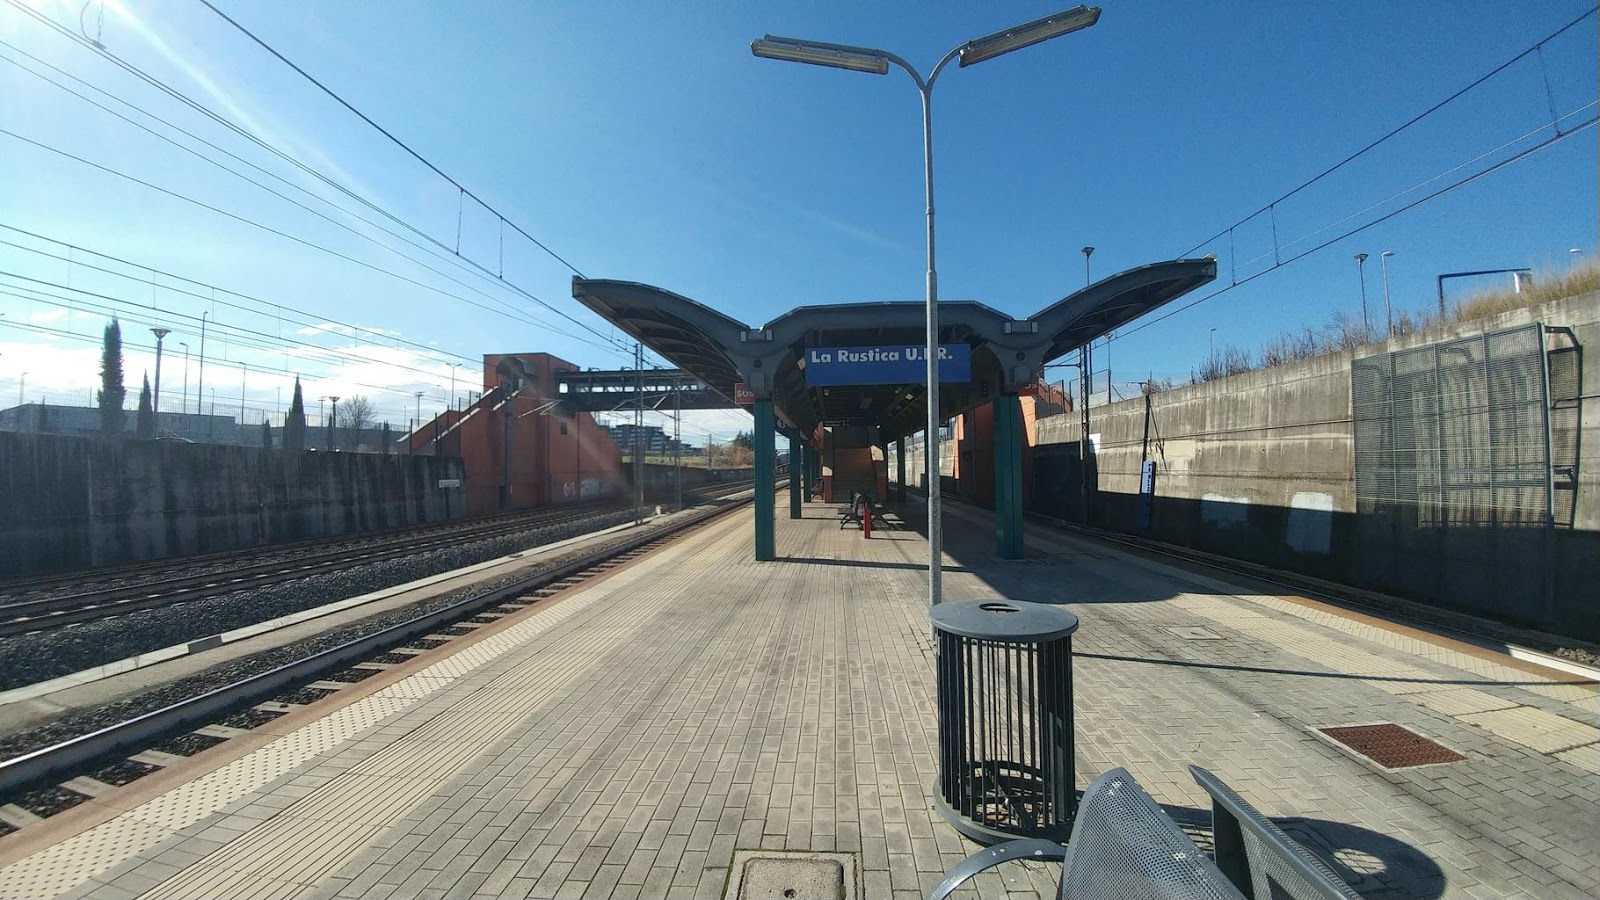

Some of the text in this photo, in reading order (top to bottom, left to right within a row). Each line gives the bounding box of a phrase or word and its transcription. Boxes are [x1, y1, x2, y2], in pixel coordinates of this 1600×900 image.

[811, 350, 831, 363] La
[837, 348, 899, 363] Rustica
[736, 389, 755, 398] SOS
